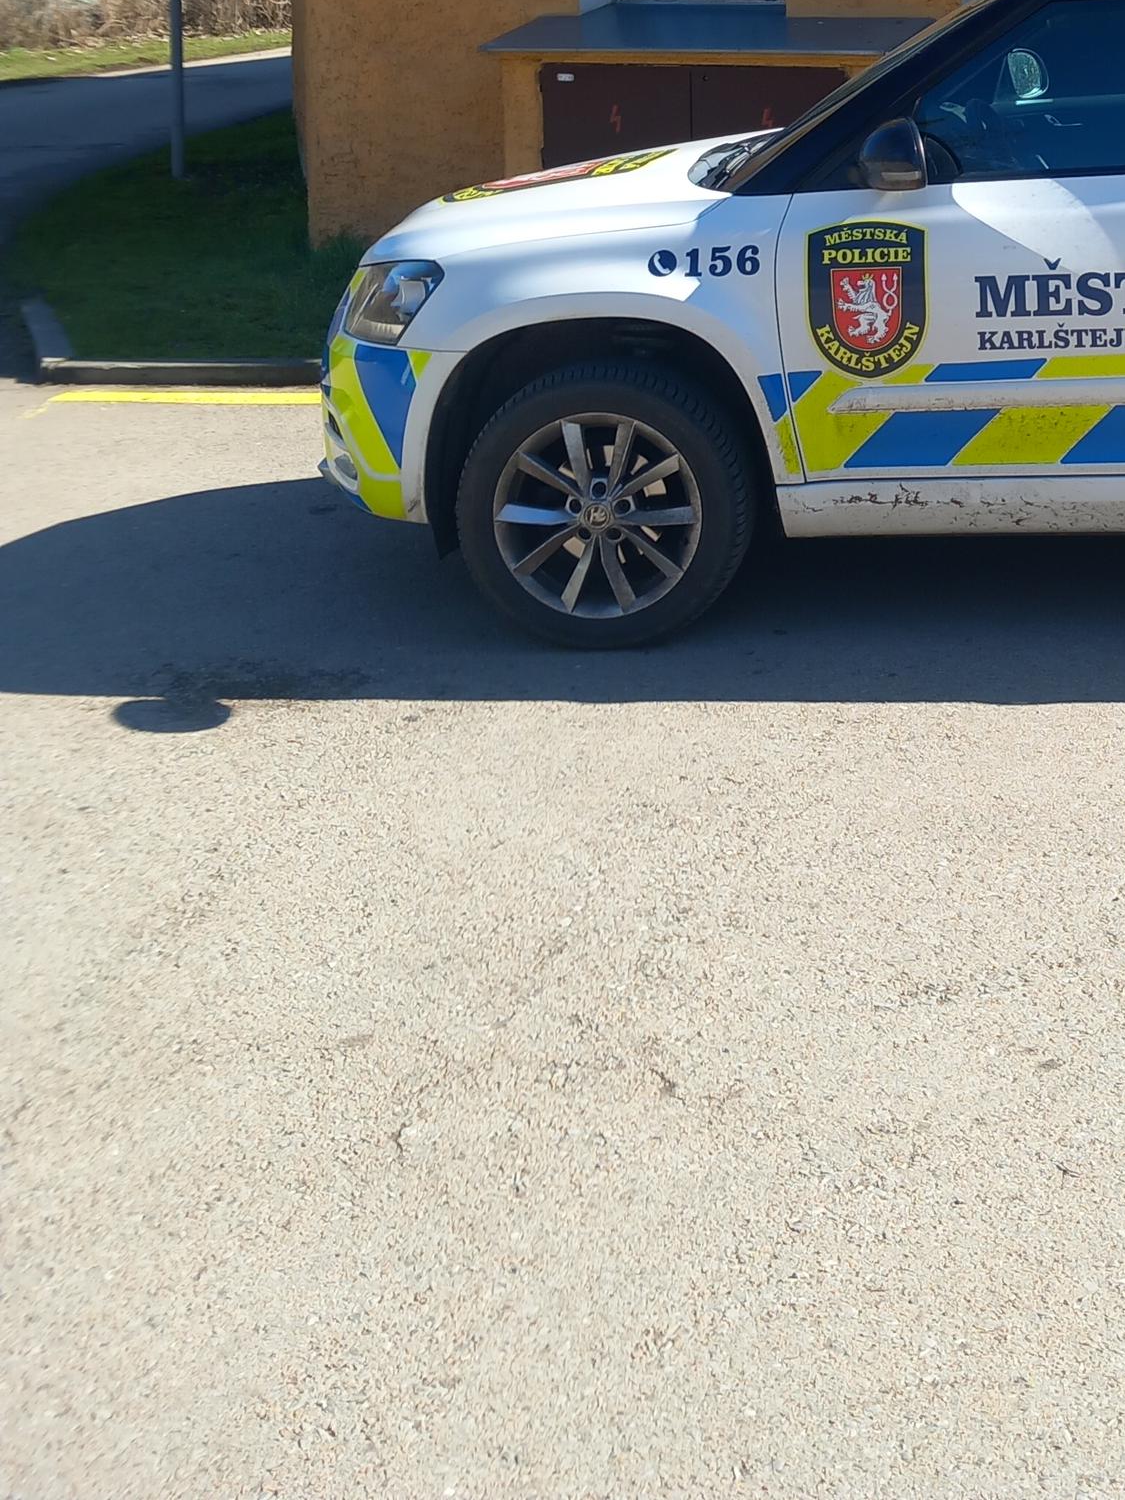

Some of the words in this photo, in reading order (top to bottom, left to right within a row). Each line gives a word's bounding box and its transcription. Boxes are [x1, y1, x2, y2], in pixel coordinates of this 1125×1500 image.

[824, 227, 909, 246] MĚSTSKÁ
[684, 244, 761, 277] 156
[822, 247, 912, 265] POLICIE
[816, 322, 920, 371] KARLŠTEJN
